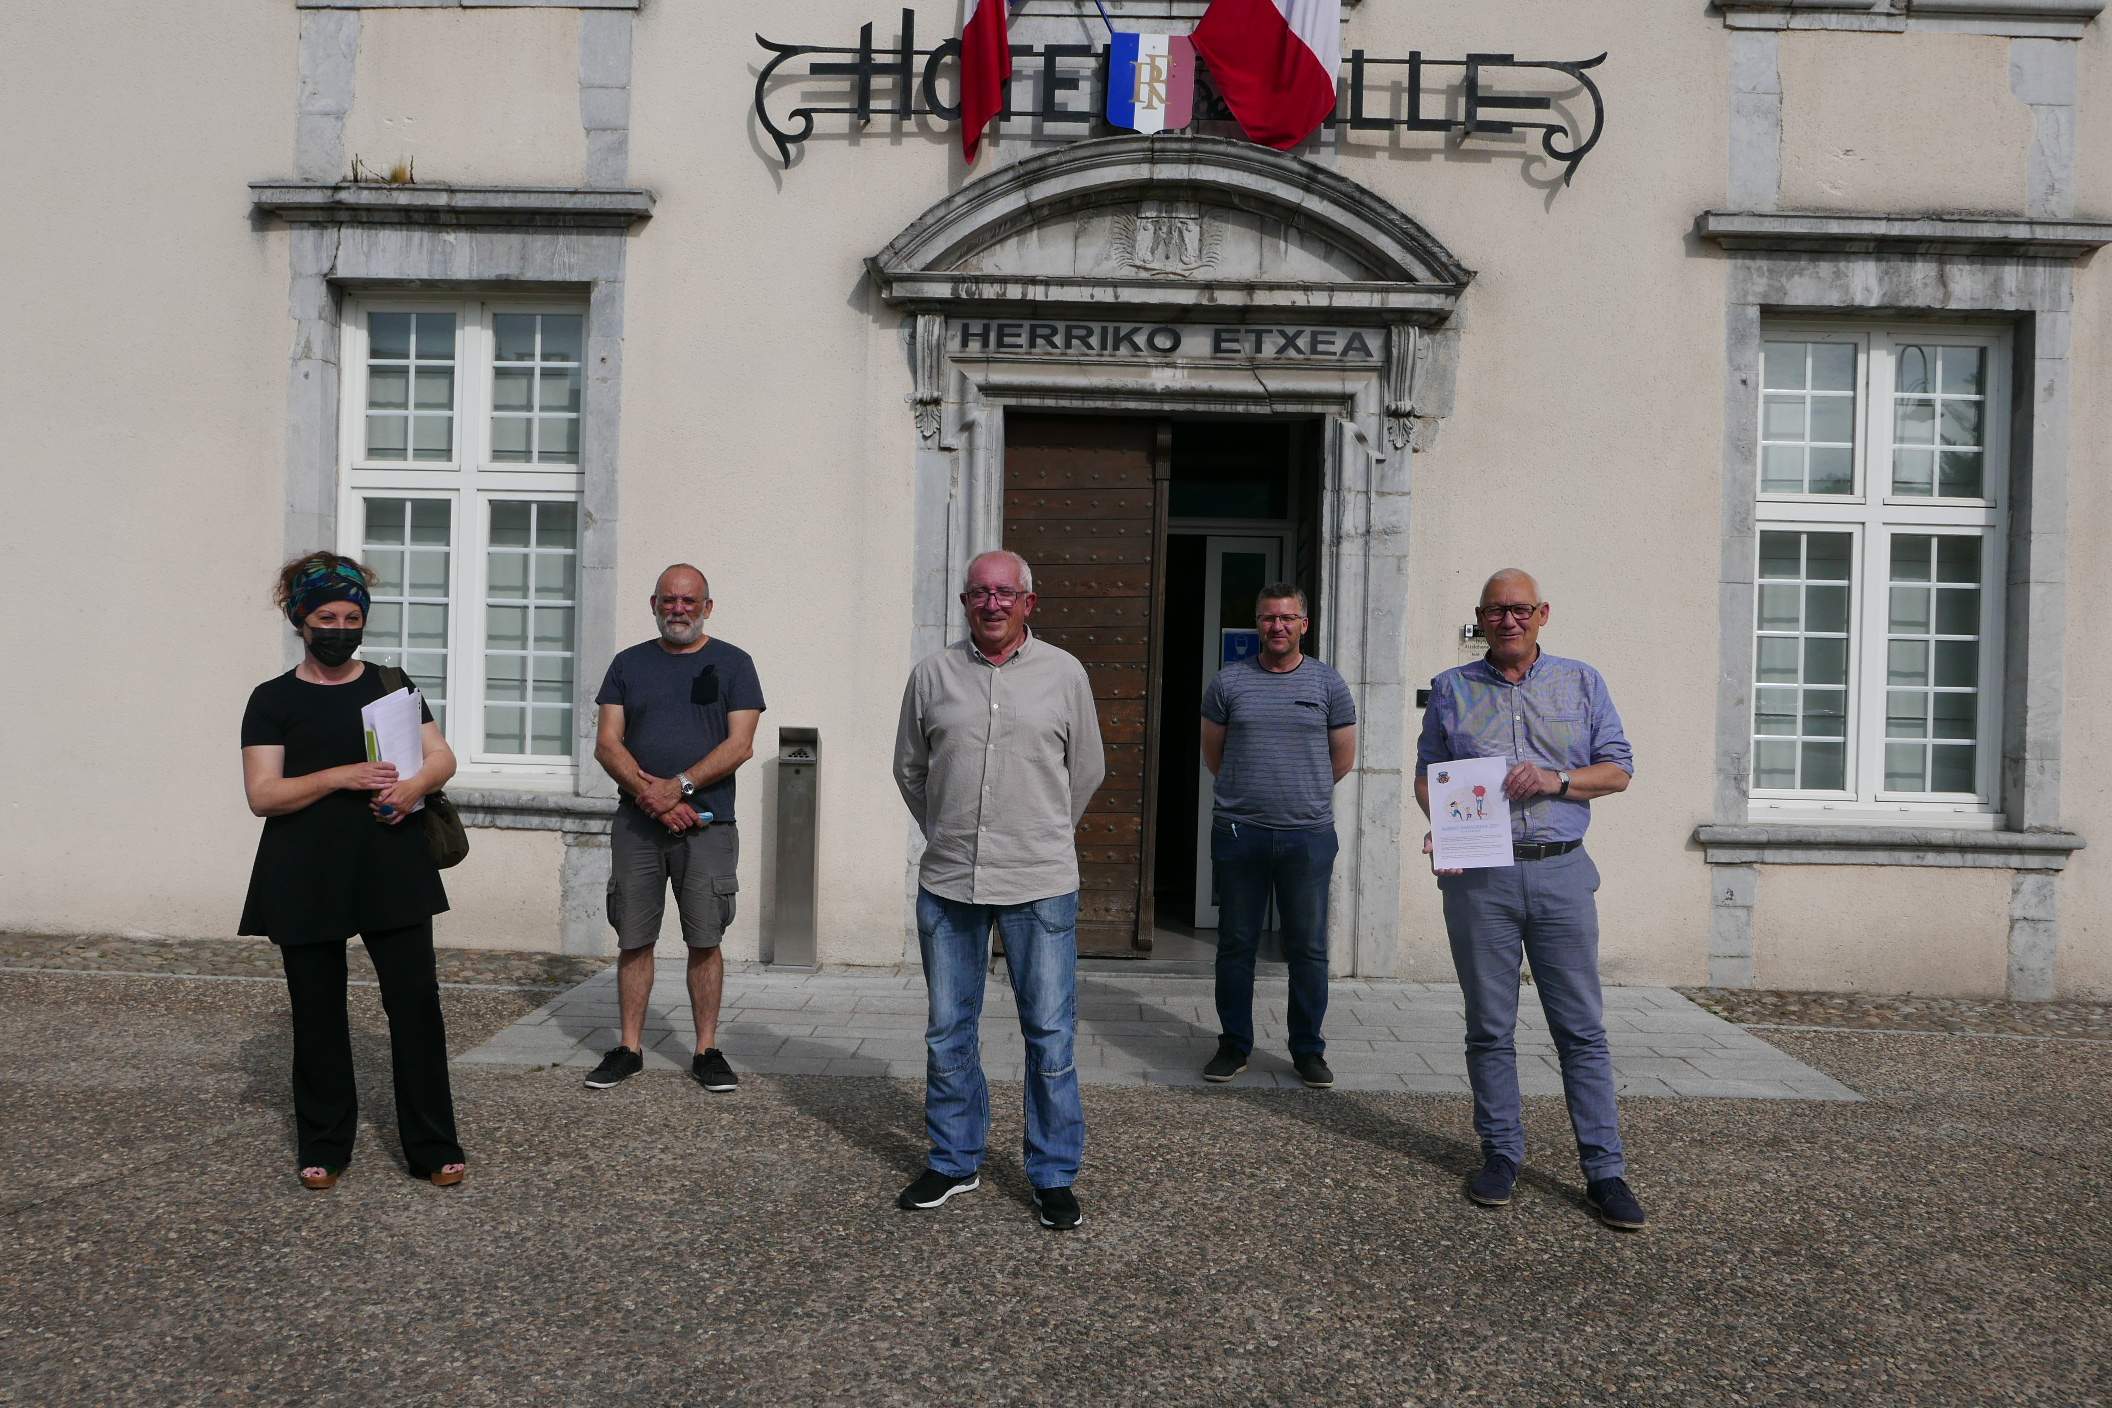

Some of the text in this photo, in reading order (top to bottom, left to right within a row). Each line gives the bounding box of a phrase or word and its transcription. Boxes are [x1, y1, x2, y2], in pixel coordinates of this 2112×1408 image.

[1323, 49, 1551, 134] LLE
[960, 322, 1374, 358] HERRIKO ETXEA
